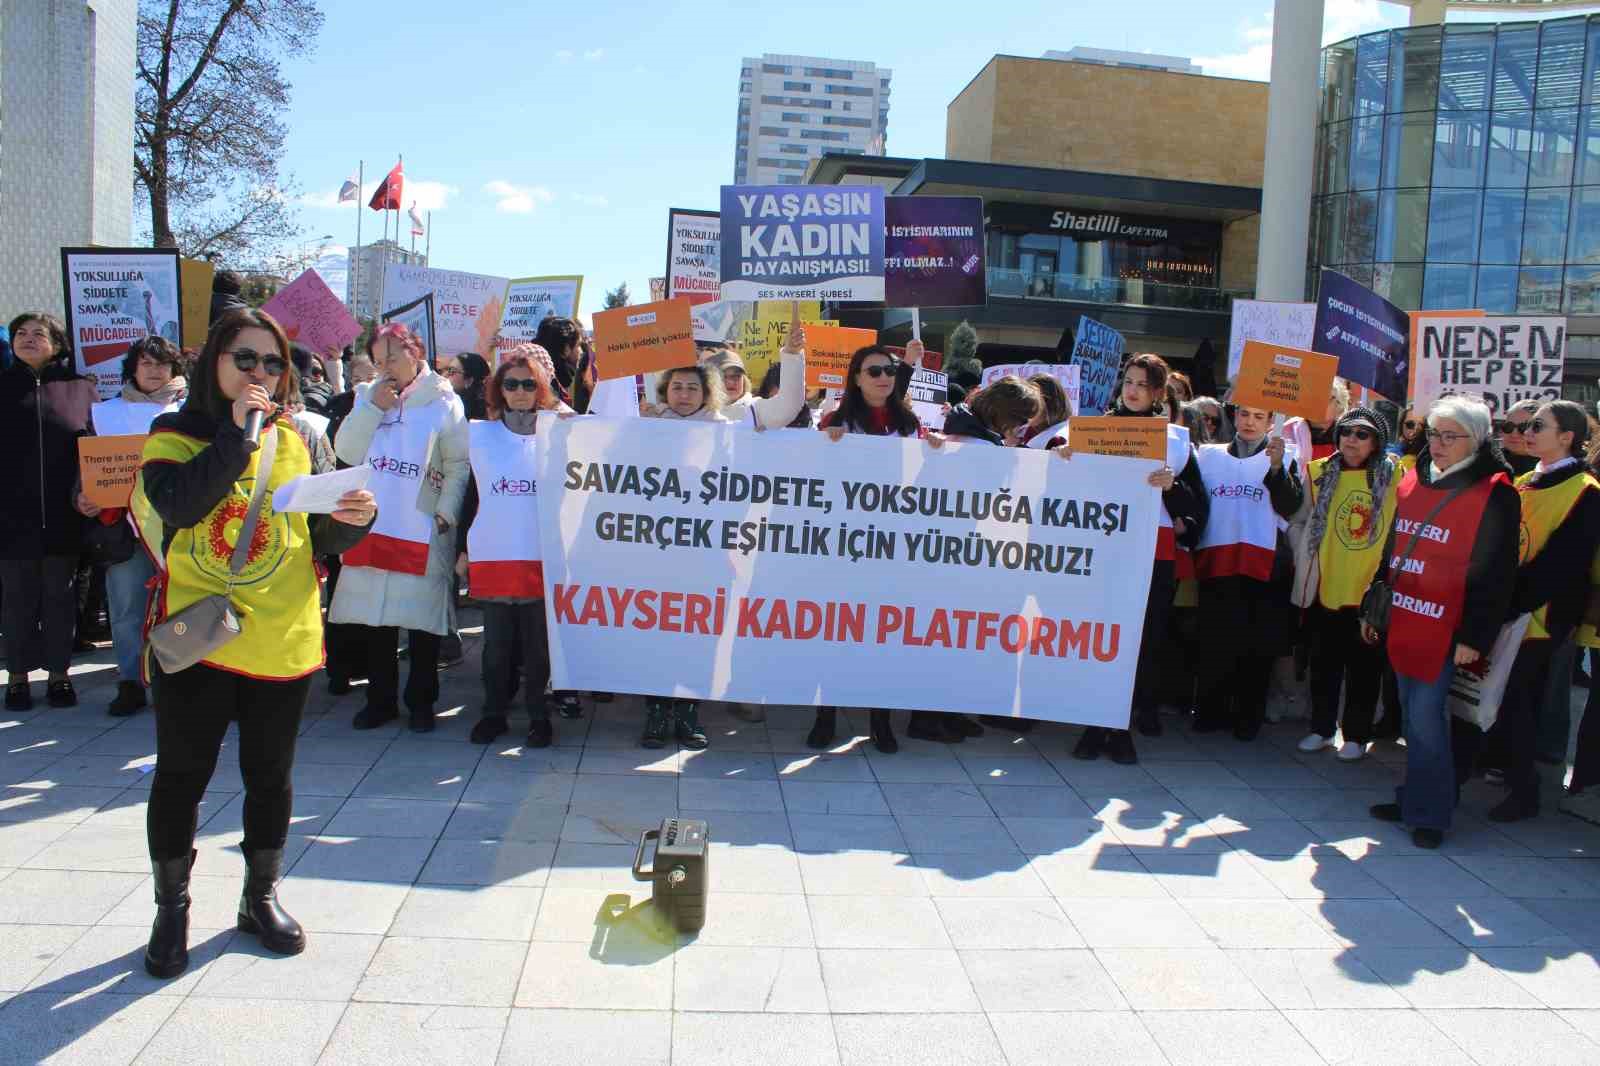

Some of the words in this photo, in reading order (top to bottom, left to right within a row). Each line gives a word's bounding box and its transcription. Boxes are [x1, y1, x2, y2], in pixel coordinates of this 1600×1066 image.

[738, 192, 871, 222] YAŞASIN
[1050, 211, 1120, 233] Shatilli
[676, 228, 720, 241] YOKSULLU
[741, 223, 870, 257] KADIN
[74, 270, 144, 281] YOKSULLUĞA
[741, 258, 870, 278] DAYANIŞMASI!
[83, 287, 128, 301] ŞİDDETE
[758, 290, 774, 298] SES
[778, 288, 816, 298] KAYSERİ
[78, 304, 118, 318] SAVAŞA
[1423, 325, 1563, 359] NEDEN
[1440, 359, 1503, 384] HEP
[1509, 359, 1563, 387] BİZ
[84, 454, 112, 463] There
[564, 461, 691, 504] SAVAŞA,
[699, 466, 832, 514] ŞİDDETE,
[842, 481, 1032, 525] YOKSULLUĞA
[1041, 497, 1129, 537] KARŞI
[595, 511, 713, 550] GERÇEK
[721, 517, 831, 556] EŞİTLİK
[838, 522, 896, 562] İÇİN
[904, 528, 1093, 576] YÜRÜYORUZ!
[553, 583, 726, 637] KAYSERİ
[737, 596, 866, 643] KADIN
[876, 604, 1121, 663] PLATFORMU
